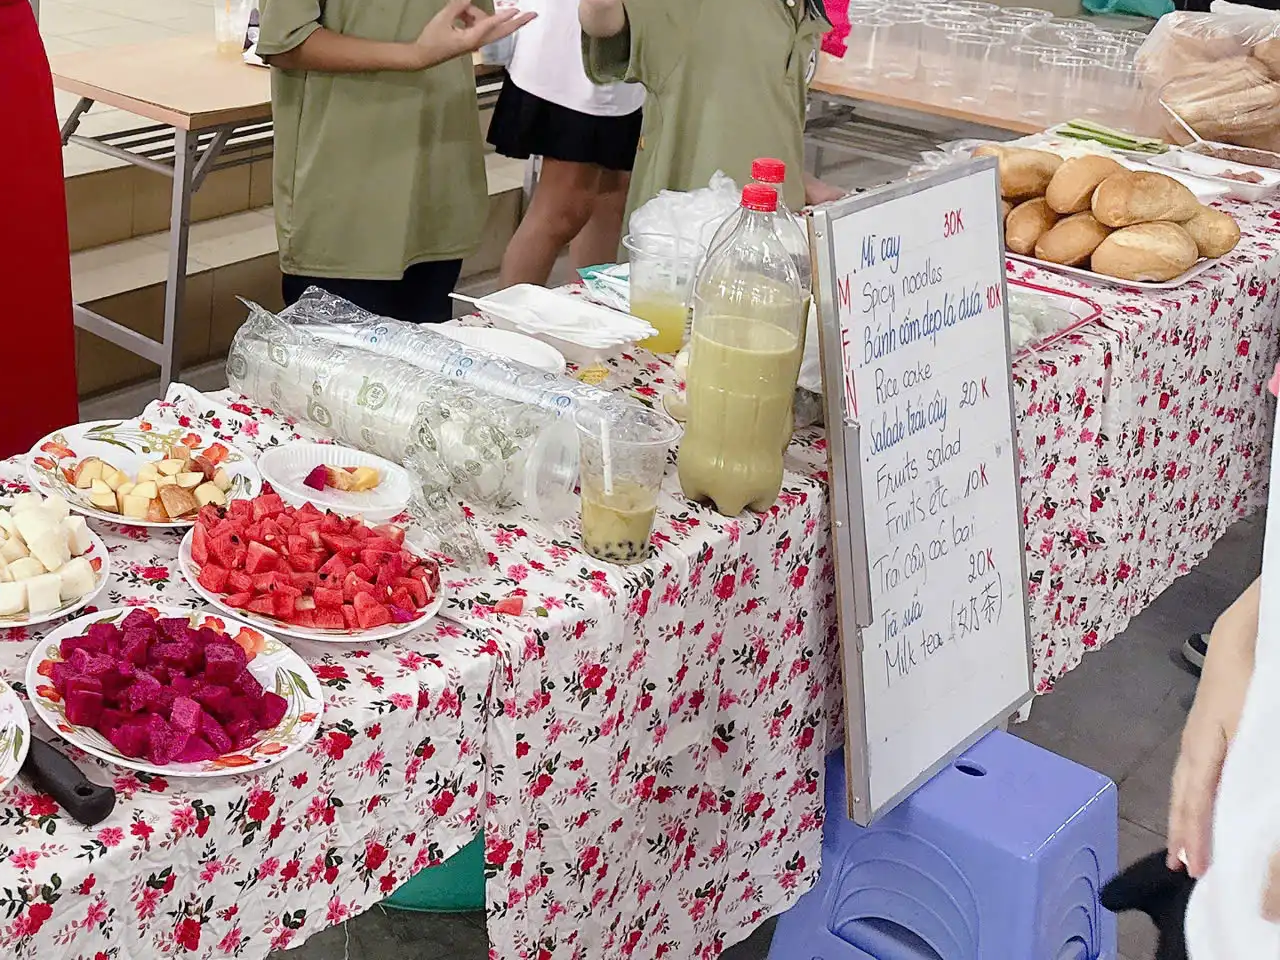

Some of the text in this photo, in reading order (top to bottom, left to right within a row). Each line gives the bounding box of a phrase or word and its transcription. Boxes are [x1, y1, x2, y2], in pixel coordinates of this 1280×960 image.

[880, 235, 901, 274] cay
[943, 207, 964, 238] 30K
[862, 256, 943, 321] Spicy noodles
[864, 313, 896, 365] Bánh
[986, 282, 1002, 309] 10K
[874, 360, 933, 405] Rice cake
[870, 405, 905, 456] Salade
[928, 388, 948, 433] cây
[876, 427, 961, 501] Fruits salad
[885, 489, 926, 542] Fruits
[963, 462, 989, 499] 10K
[885, 635, 917, 687] Milk
[920, 630, 944, 660] tea
